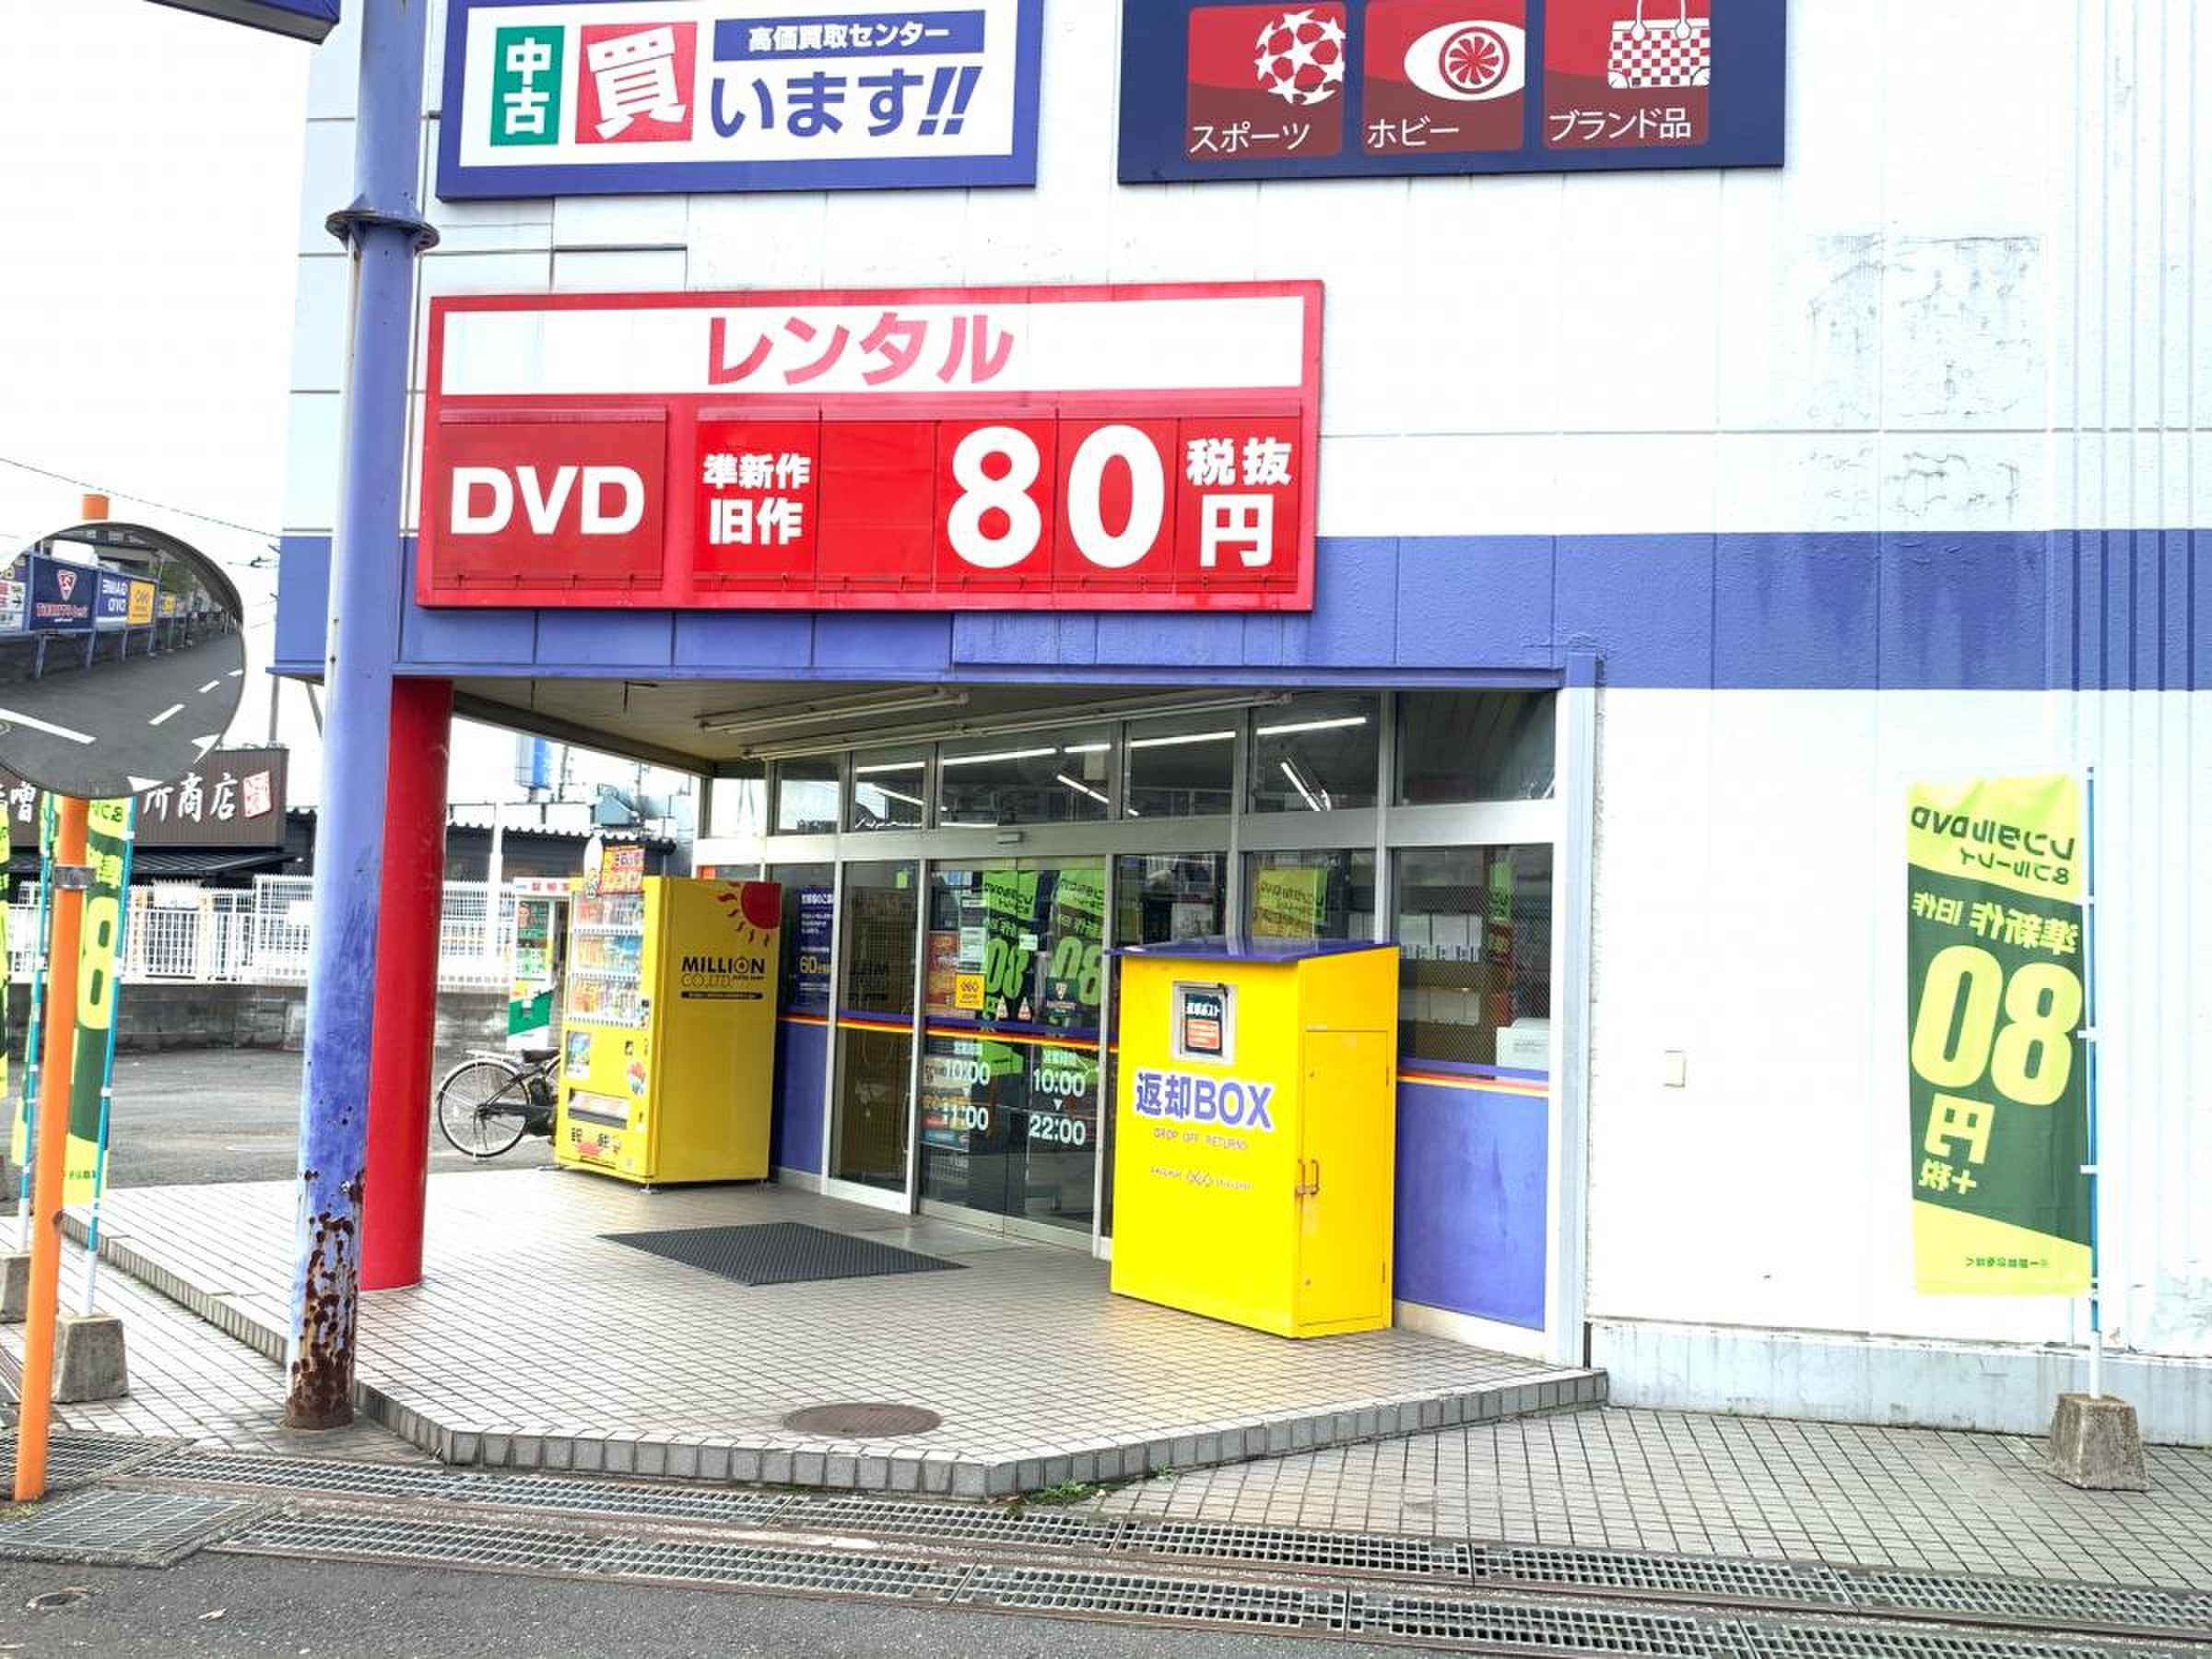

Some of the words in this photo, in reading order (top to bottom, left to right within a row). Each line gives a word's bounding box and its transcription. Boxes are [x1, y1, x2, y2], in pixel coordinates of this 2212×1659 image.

[748, 22, 950, 53] 高価買取センター
[504, 37, 551, 135] 中古
[586, 26, 687, 141] 買
[1188, 121, 1311, 154] スポーツ
[1366, 116, 1461, 148] ホビー
[1548, 108, 1692, 142] ブランド品
[708, 313, 1015, 385] レンタル
[702, 453, 811, 490] 準新作
[1186, 438, 1292, 488] 税抜
[450, 465, 645, 535] DVD
[947, 424, 1166, 569] 80
[709, 498, 803, 547] 旧作
[1199, 494, 1274, 568] 円
[682, 956, 765, 974] MILLION
[1033, 1067, 1086, 1097] 10:00
[1135, 1072, 1273, 1129] 返却BOX
[1029, 1114, 1086, 1146] 22:00
